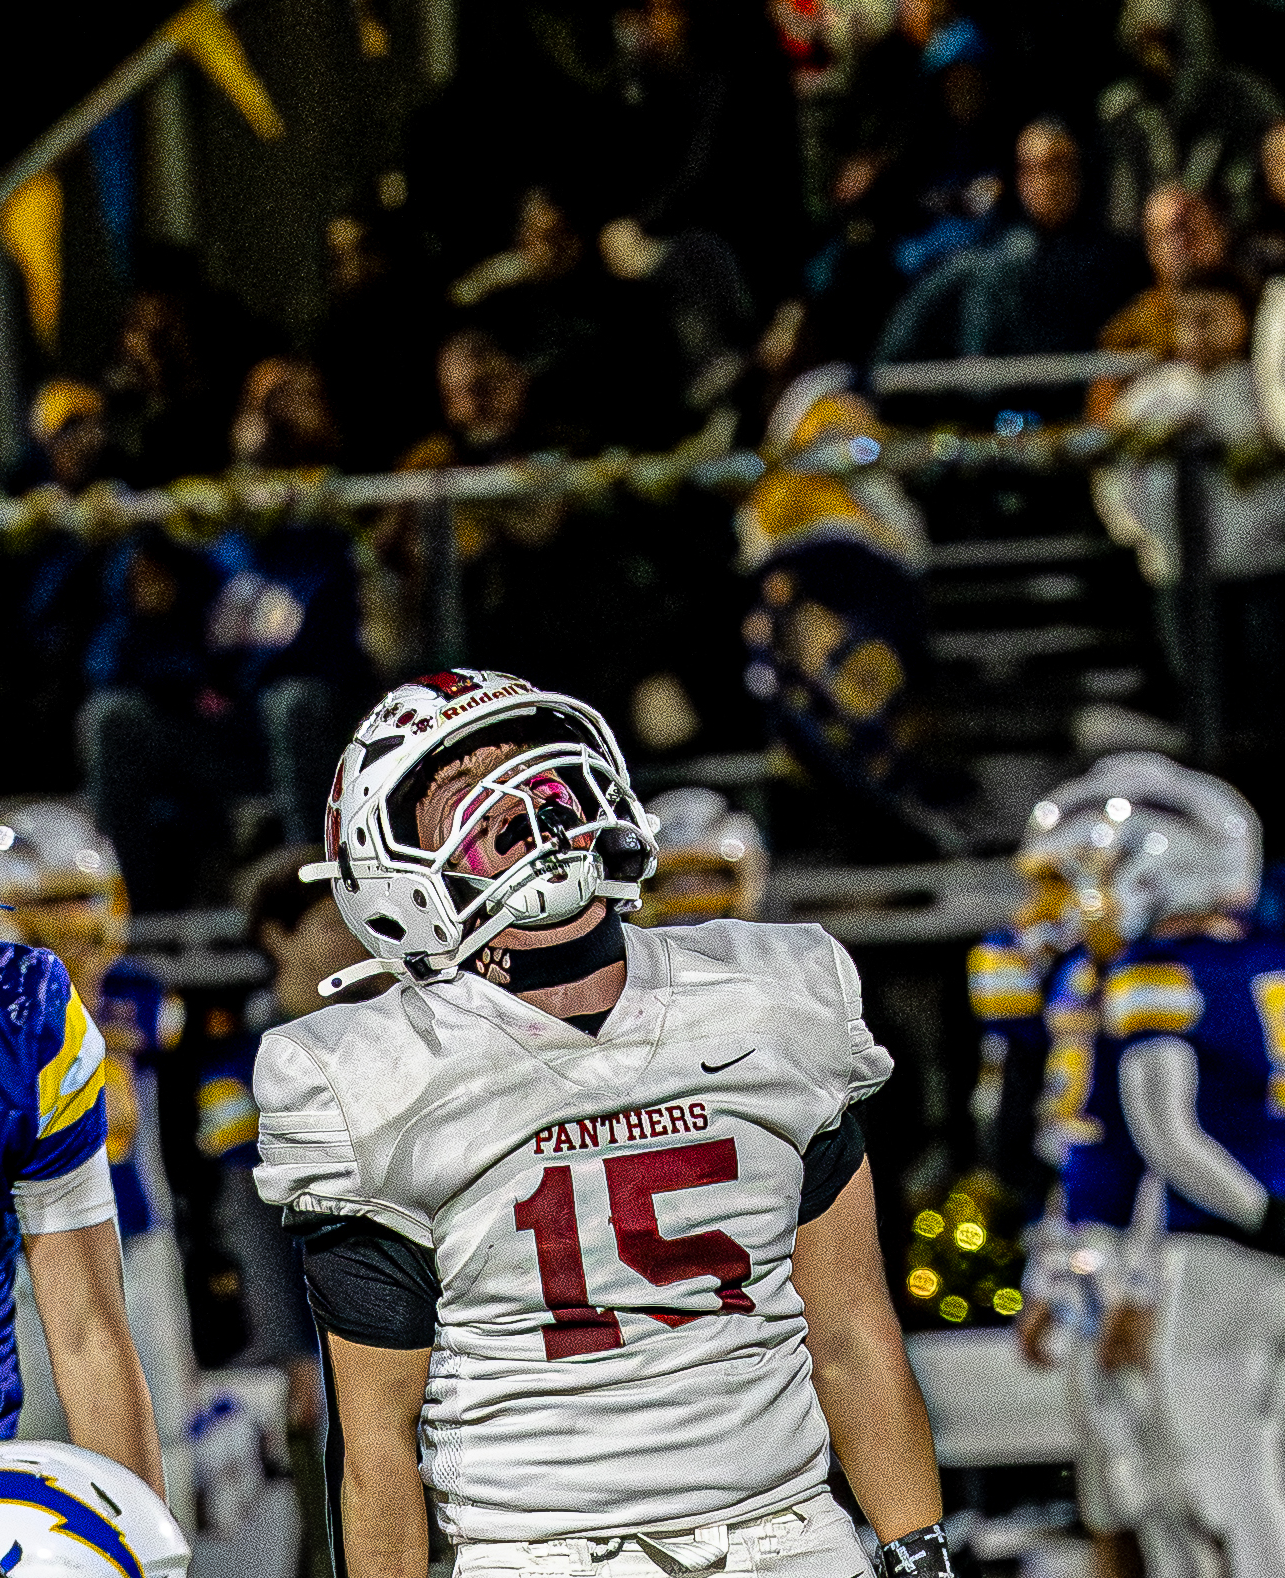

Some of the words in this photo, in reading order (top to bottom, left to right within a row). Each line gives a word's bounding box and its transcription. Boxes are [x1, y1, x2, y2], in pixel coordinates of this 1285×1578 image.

[441, 684, 519, 720] Riddell
[534, 1102, 709, 1155] PANTHERS
[513, 1136, 757, 1361] 15
